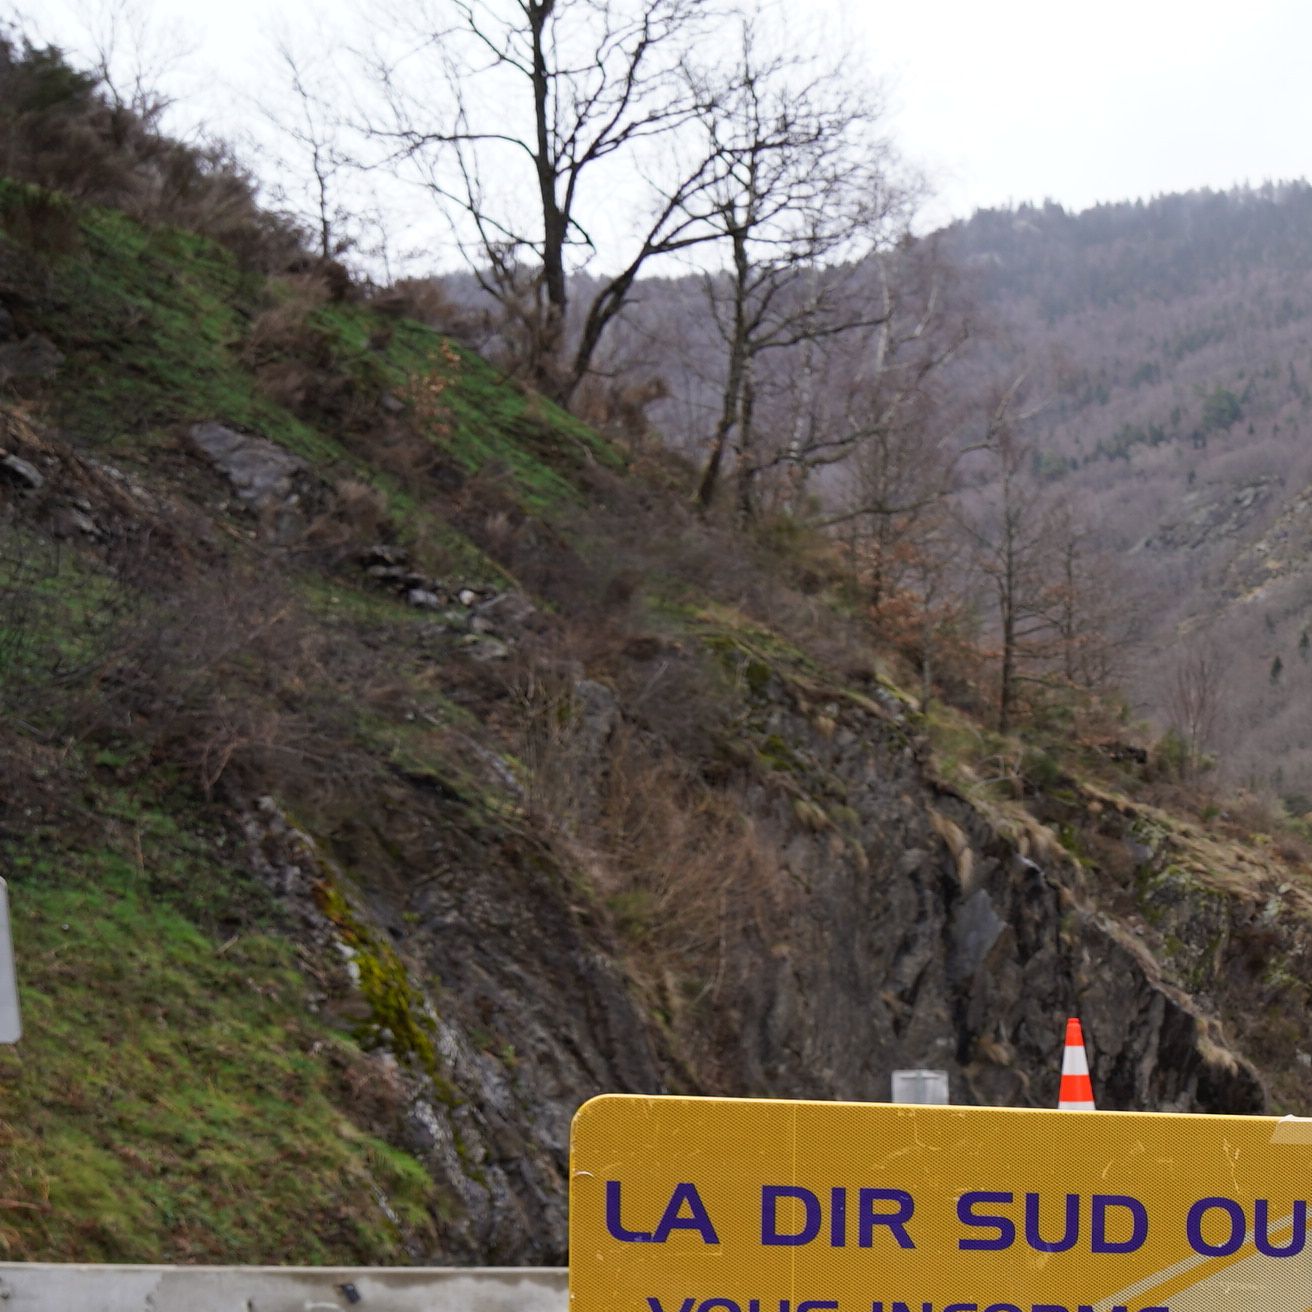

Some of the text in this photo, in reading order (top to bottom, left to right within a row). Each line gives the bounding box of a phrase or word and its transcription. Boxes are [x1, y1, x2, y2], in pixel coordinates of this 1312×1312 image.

[607, 1181, 718, 1244] LA
[762, 1186, 914, 1249] DIR
[957, 1192, 1147, 1253] SUD
